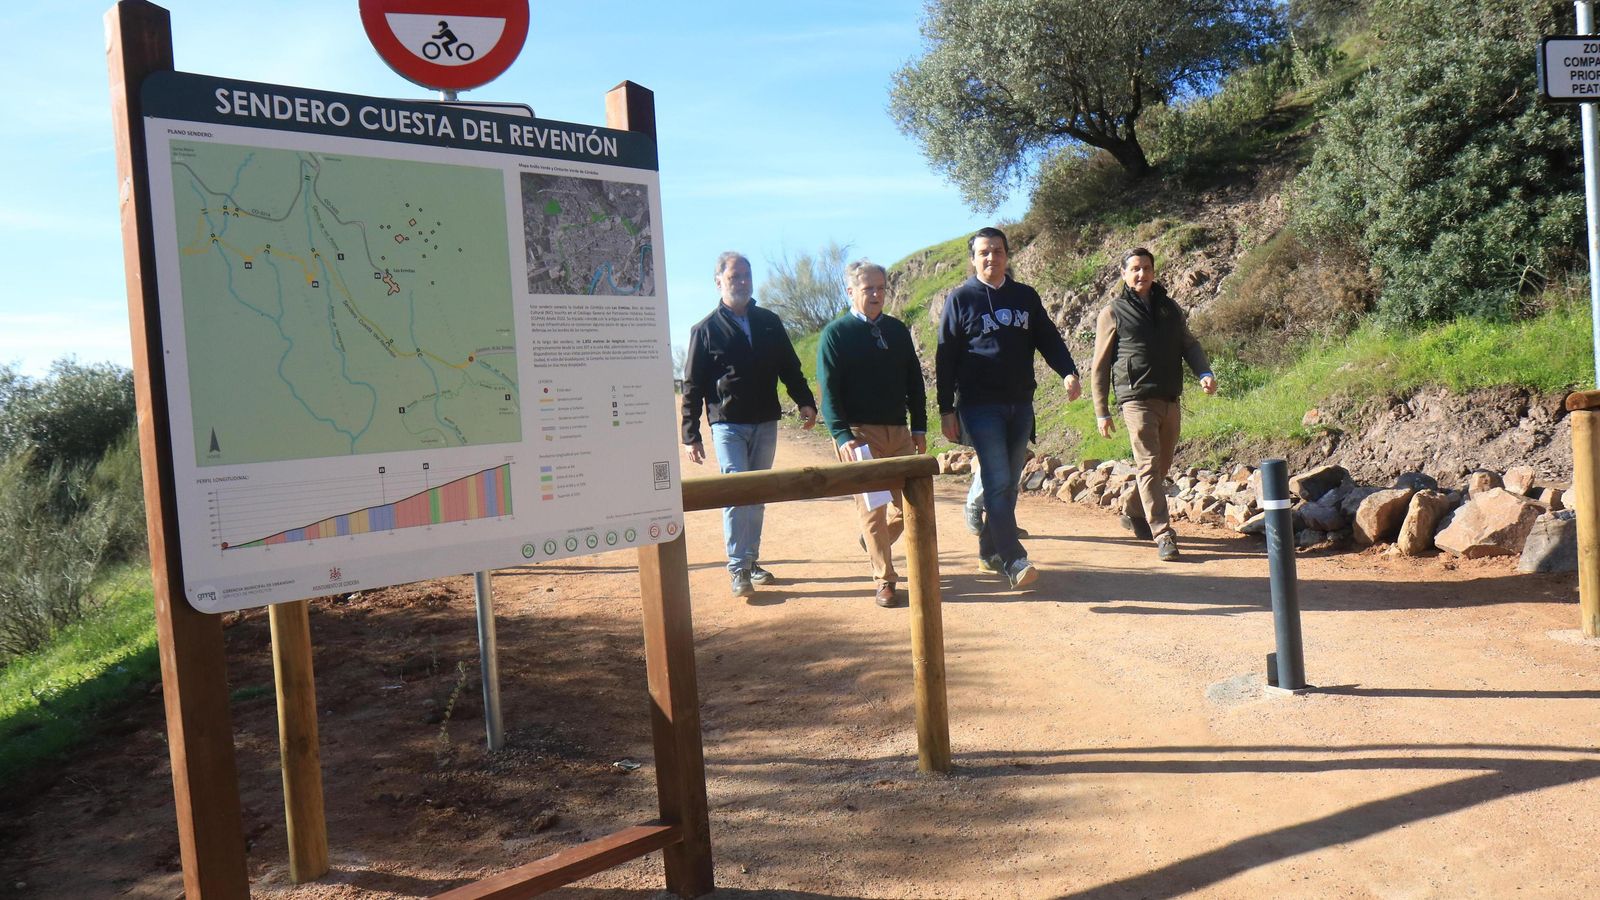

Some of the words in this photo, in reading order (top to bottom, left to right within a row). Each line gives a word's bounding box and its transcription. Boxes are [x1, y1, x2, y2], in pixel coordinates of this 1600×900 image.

[1584, 43, 1600, 54] ZO
[1572, 83, 1600, 94] PEAT
[215, 88, 351, 127] SENDERO
[358, 106, 455, 139] CUESTA
[462, 118, 503, 144] DEL
[509, 124, 618, 158] REVENTÓN
